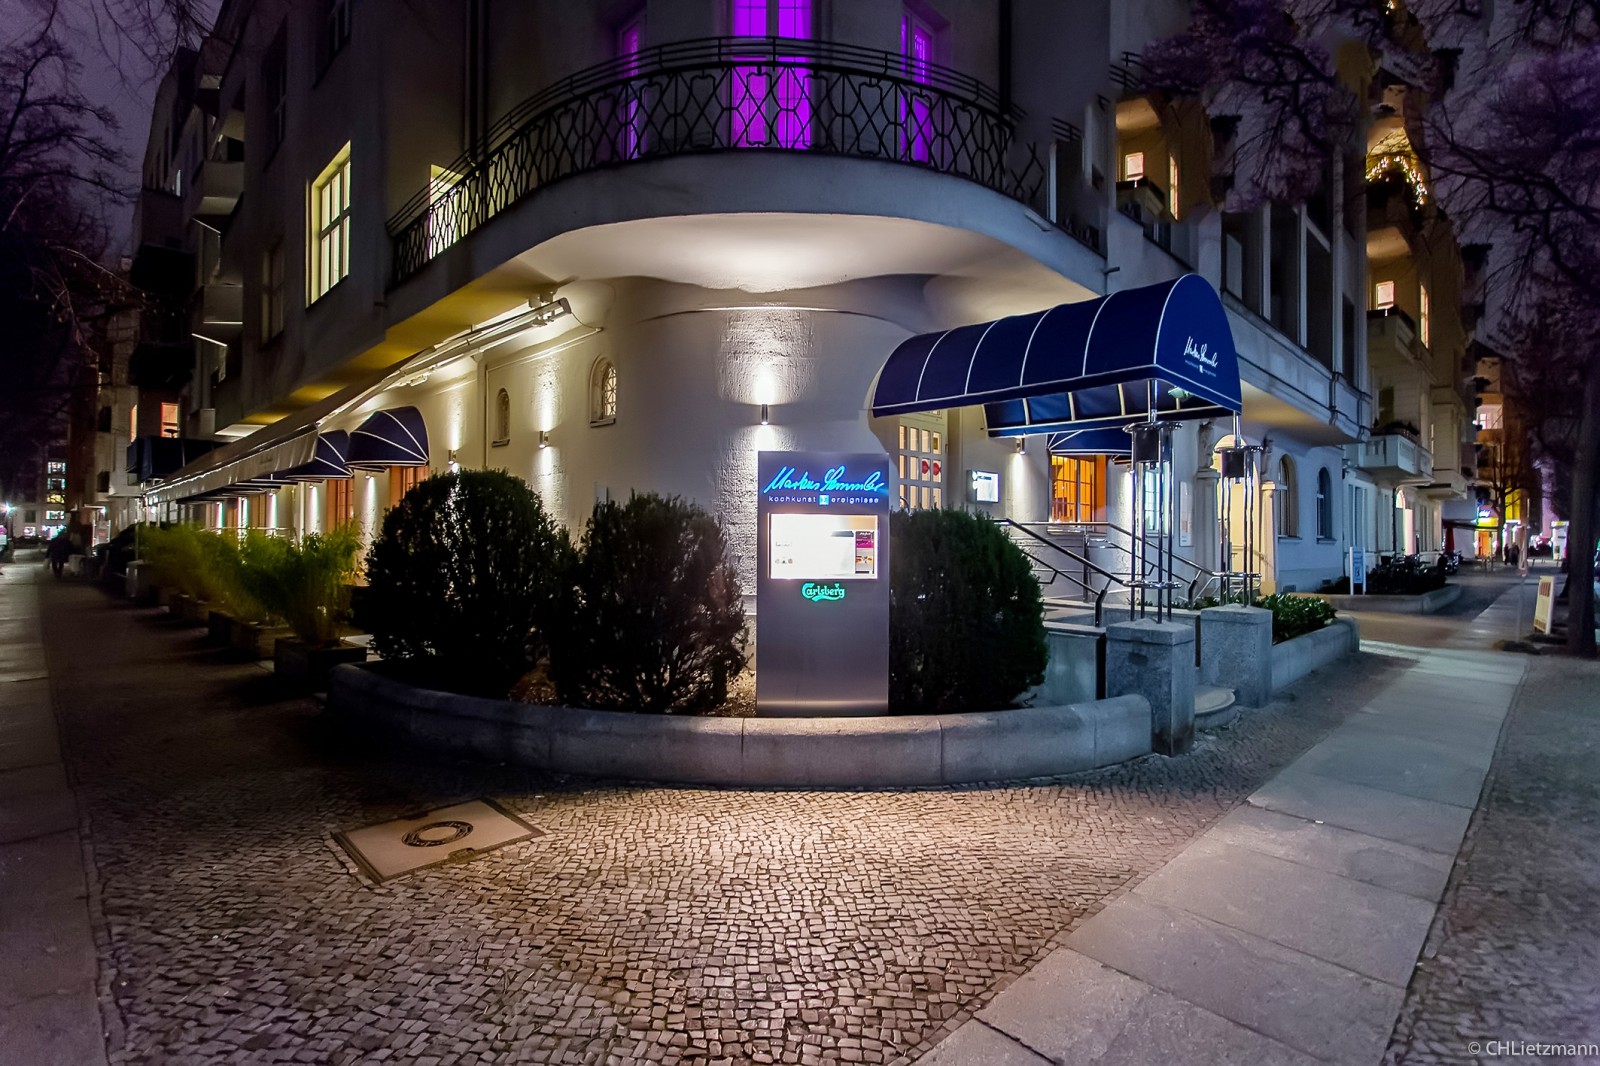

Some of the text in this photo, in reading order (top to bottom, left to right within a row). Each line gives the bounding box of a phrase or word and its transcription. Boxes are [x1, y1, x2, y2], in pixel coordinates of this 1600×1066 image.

[763, 466, 820, 493] Markus
[768, 495, 816, 503] kochkunst
[802, 583, 846, 602] Carlsberg
